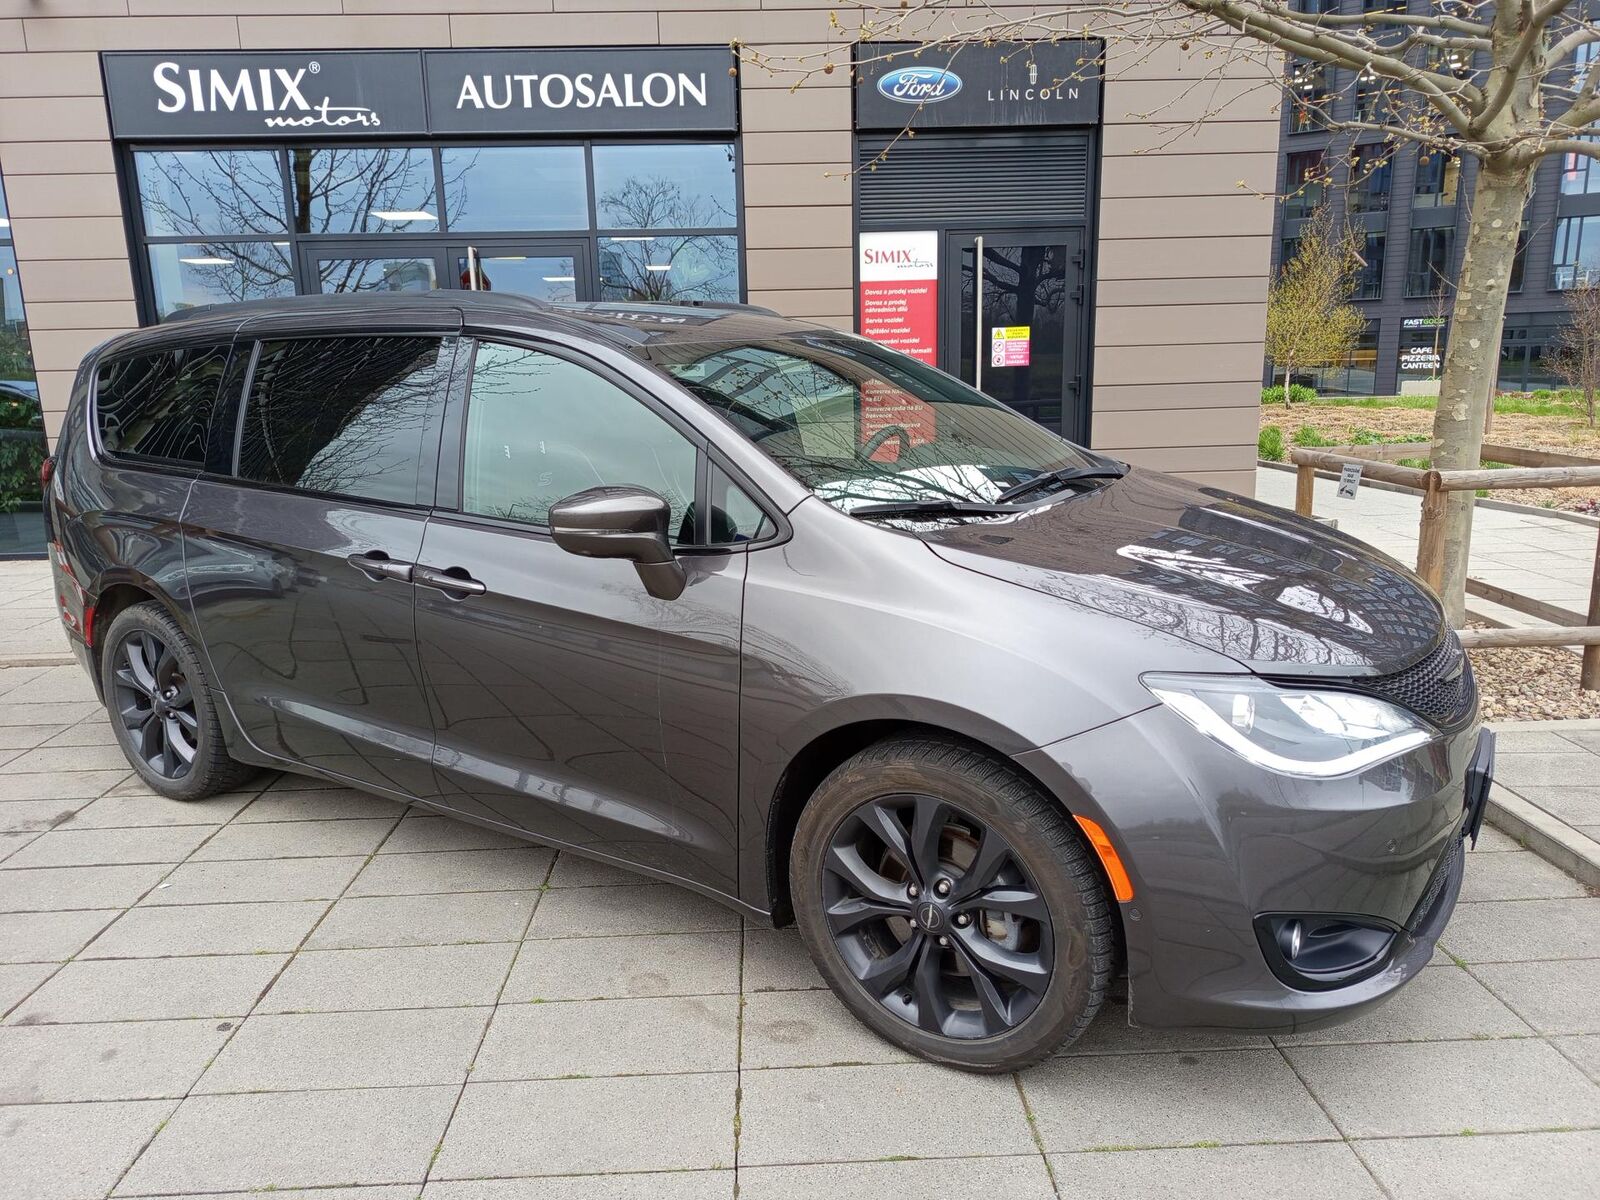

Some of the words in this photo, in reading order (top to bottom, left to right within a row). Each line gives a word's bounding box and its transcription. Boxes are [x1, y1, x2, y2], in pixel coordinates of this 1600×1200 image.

[456, 72, 707, 109] AUTOSALON
[893, 72, 946, 97] Ford
[987, 88, 1079, 101] LINCOLN
[264, 96, 381, 127] motors
[864, 248, 912, 264] SIMIX
[888, 288, 907, 296] prodej
[1401, 354, 1440, 362] PIZZERIA
